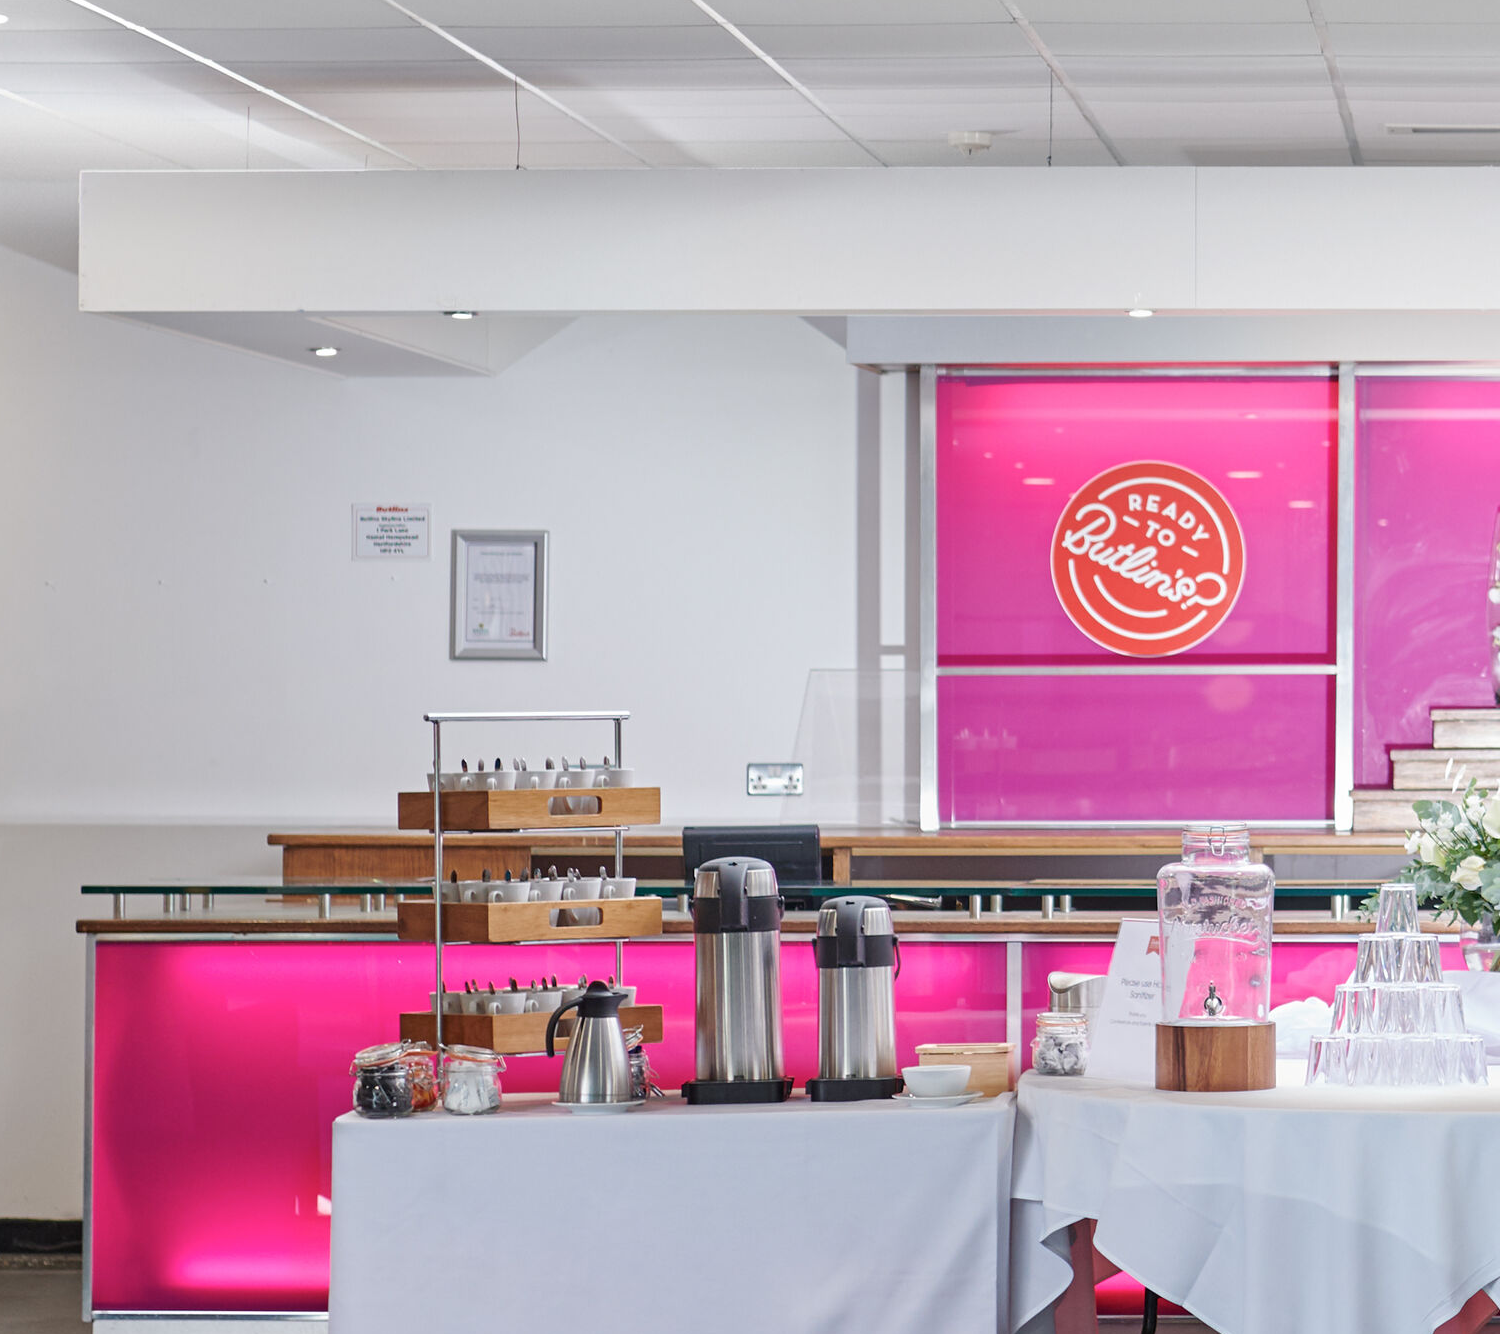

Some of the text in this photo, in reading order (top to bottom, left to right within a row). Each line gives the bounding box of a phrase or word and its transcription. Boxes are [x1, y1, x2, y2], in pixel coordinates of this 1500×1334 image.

[1128, 493, 1210, 542] READY
[1145, 520, 1176, 547] TO
[1121, 978, 1140, 988] Please
